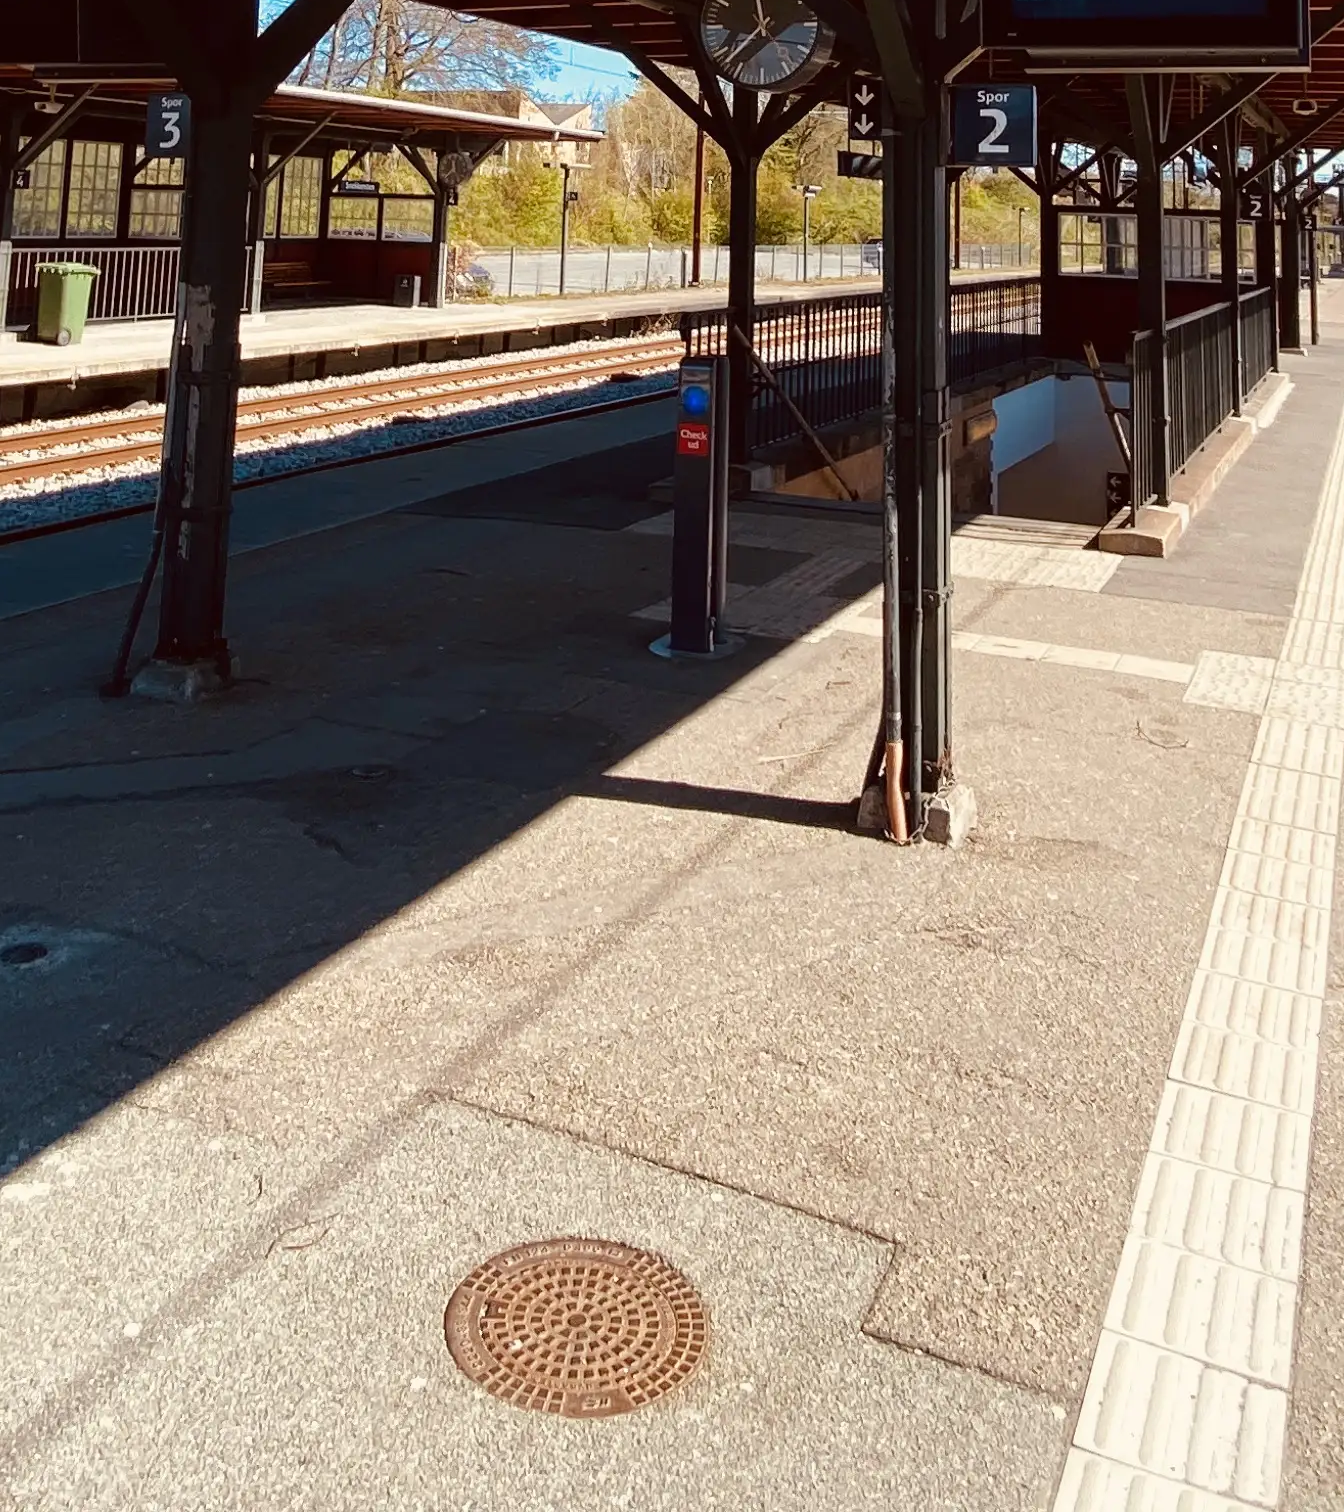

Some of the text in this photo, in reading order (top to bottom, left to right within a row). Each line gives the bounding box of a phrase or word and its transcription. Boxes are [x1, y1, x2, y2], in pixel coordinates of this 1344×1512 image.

[161, 96, 184, 109] Spor
[977, 90, 1010, 106] Spor
[159, 111, 181, 148] 3
[978, 108, 1009, 153] 2
[16, 175, 24, 187] 4
[1249, 200, 1263, 217] 2
[1304, 219, 1313, 230] 2
[680, 429, 708, 440] Check
[687, 440, 700, 449] ud
